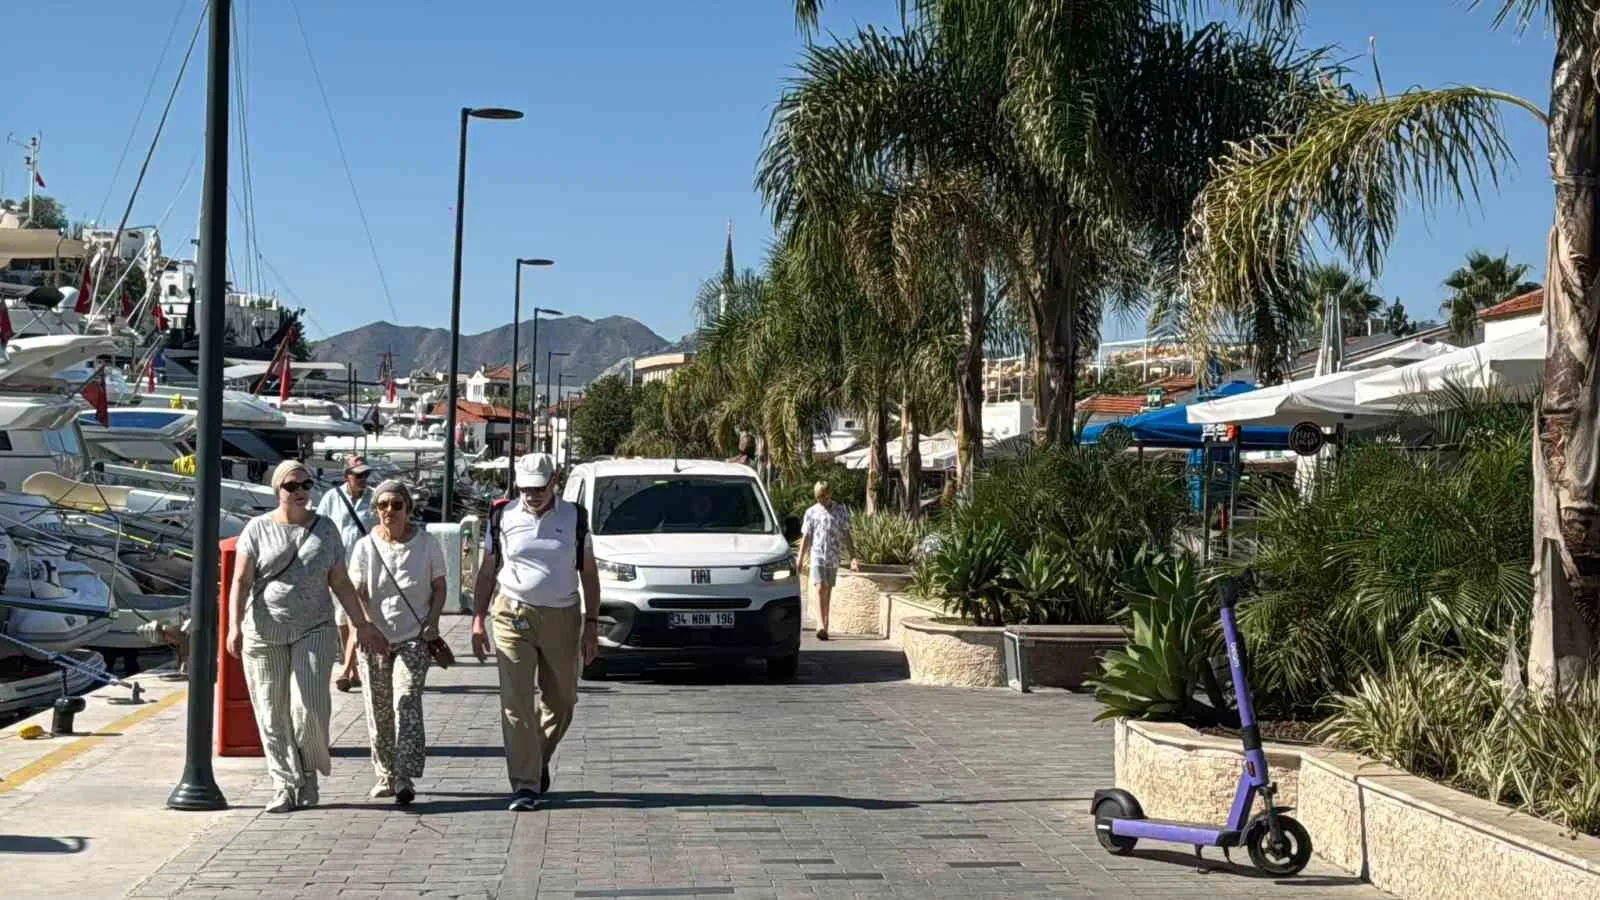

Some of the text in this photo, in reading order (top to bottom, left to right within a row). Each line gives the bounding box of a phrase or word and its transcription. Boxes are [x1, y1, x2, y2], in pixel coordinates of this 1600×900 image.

[691, 569, 711, 584] FIAT
[673, 614, 687, 625] 34
[716, 613, 733, 625] 196
